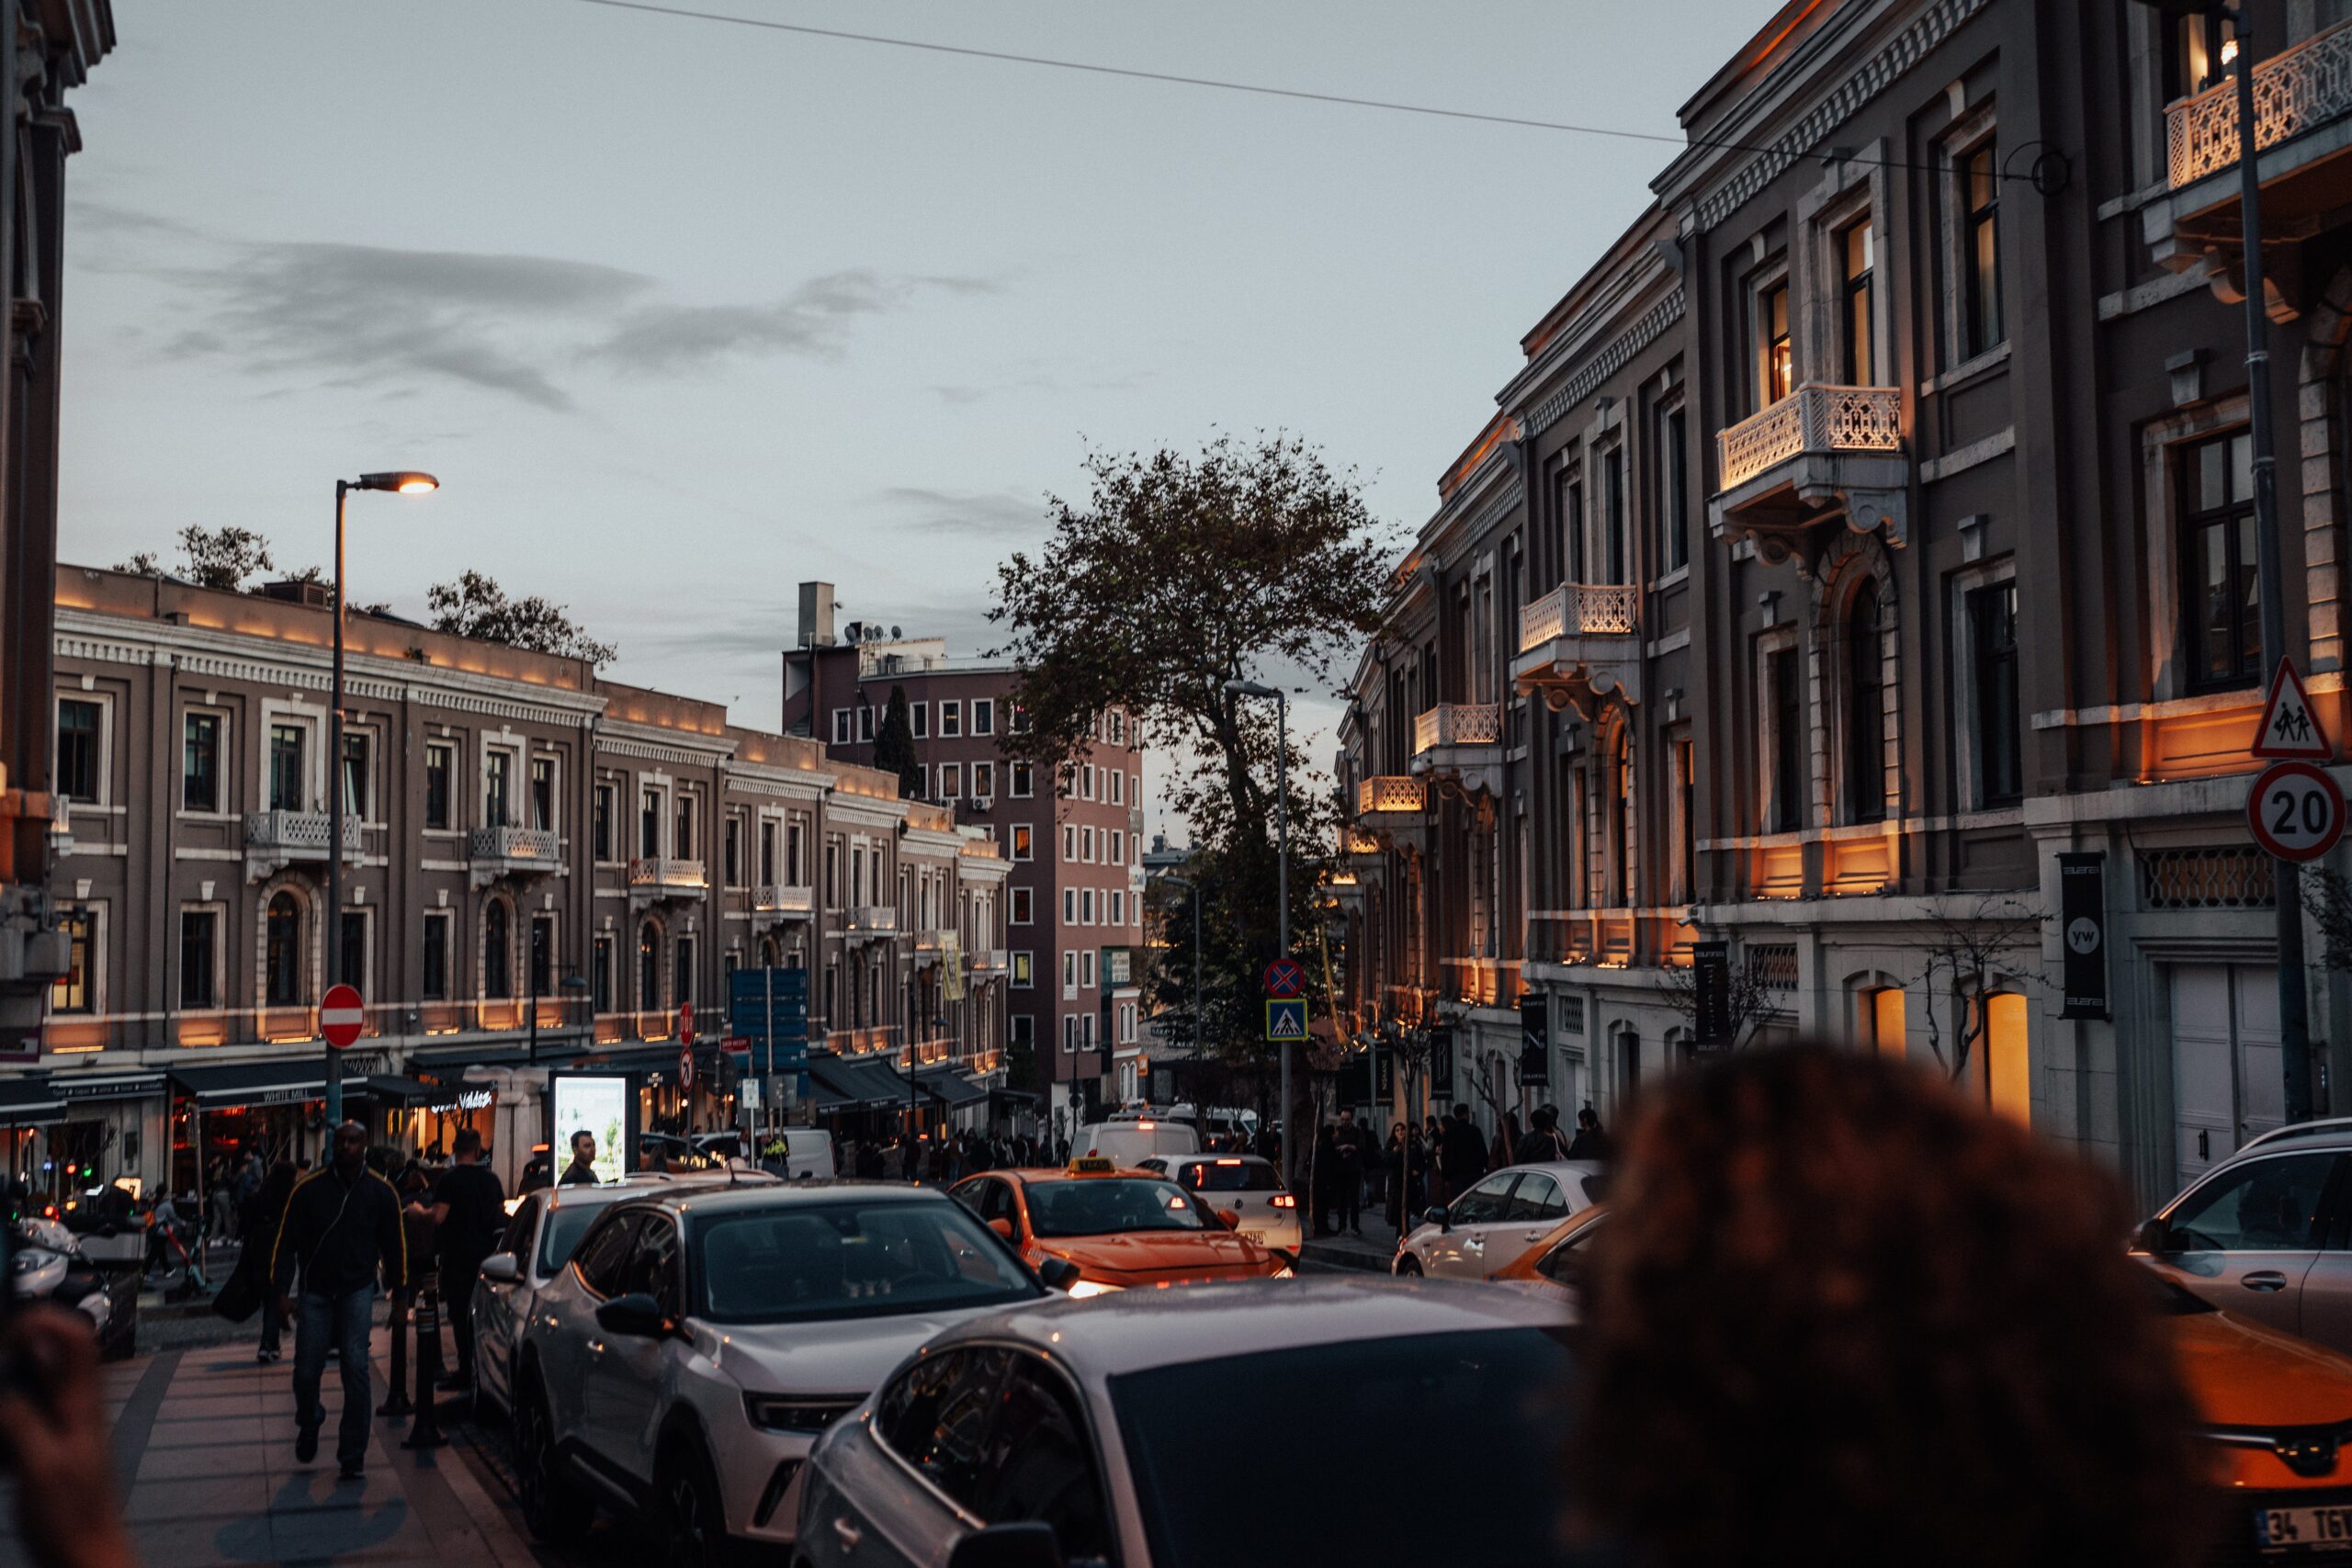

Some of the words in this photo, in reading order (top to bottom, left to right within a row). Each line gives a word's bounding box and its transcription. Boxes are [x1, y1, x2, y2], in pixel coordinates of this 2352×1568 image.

[2272, 790, 2327, 835] 20
[2073, 931, 2095, 945] yw
[680, 1016, 694, 1033] DUR
[264, 1089, 288, 1104] WHITE
[290, 1087, 310, 1100] MILL
[458, 1090, 492, 1111] Valdez
[2270, 1512, 2298, 1540] 34
